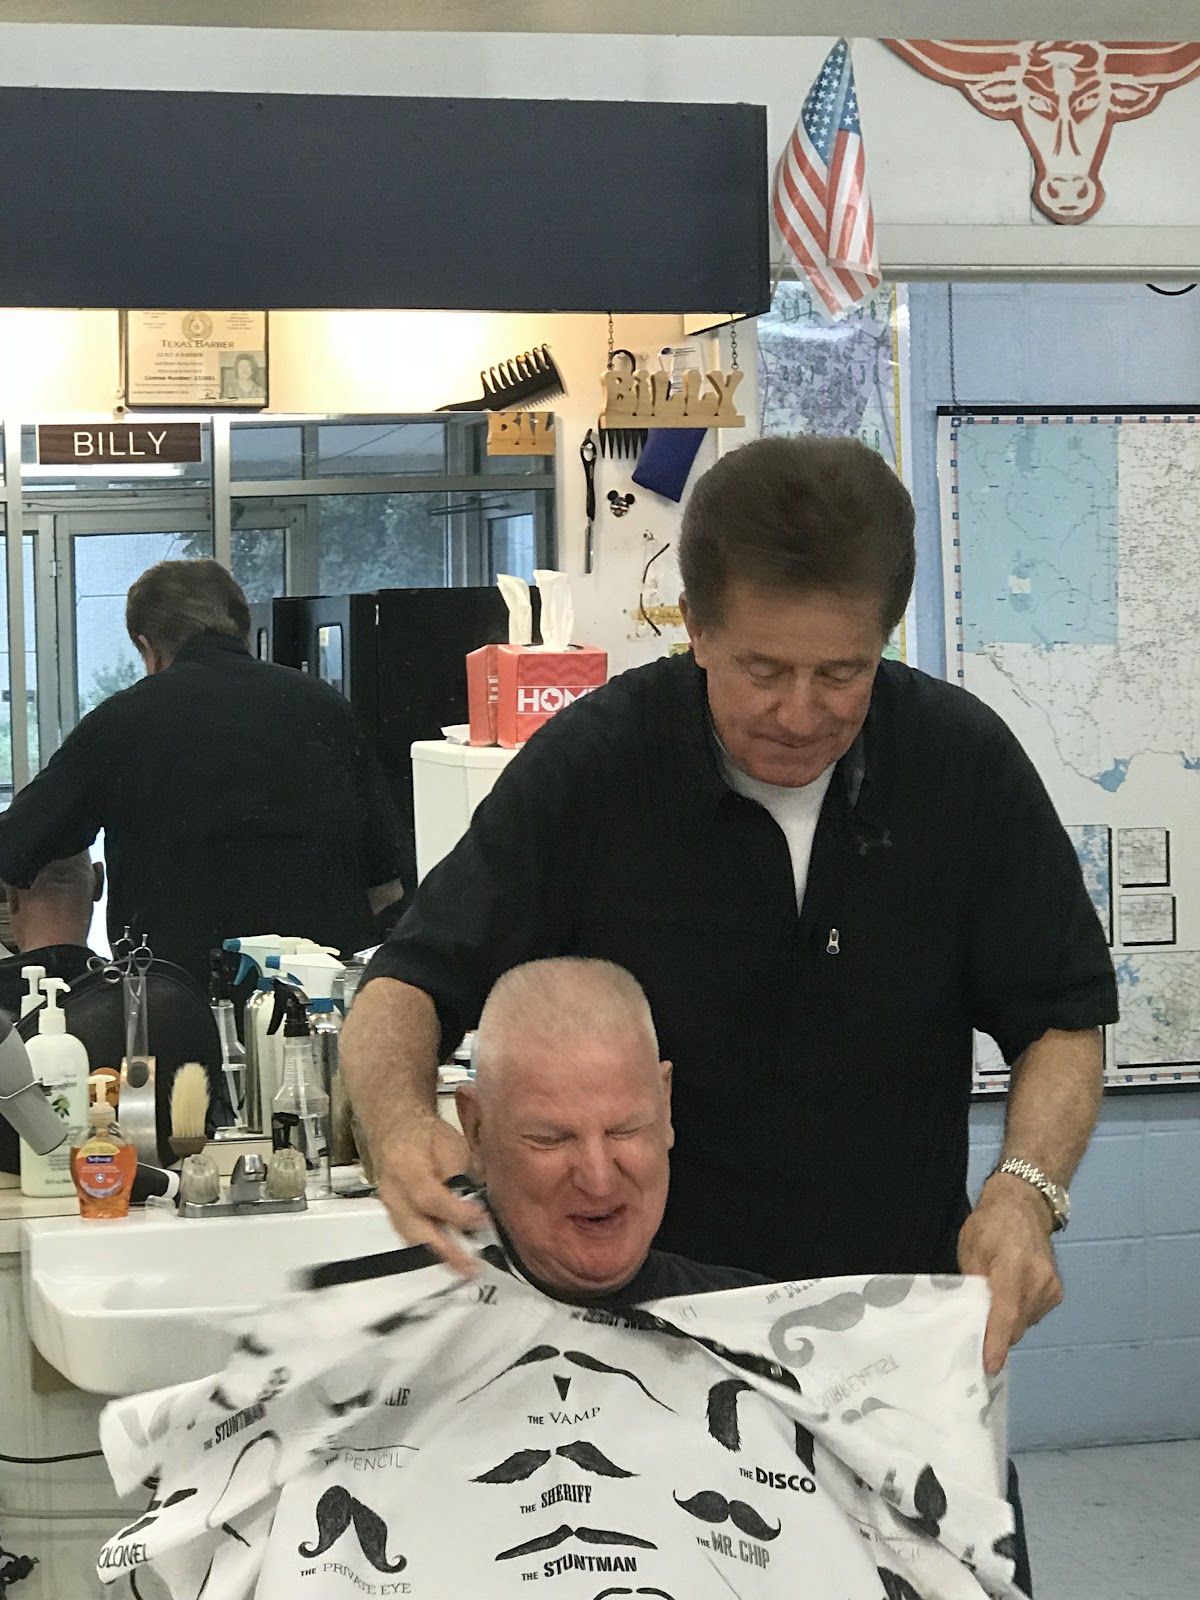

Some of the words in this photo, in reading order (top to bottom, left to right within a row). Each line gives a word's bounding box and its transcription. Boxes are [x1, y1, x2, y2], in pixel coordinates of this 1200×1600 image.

[161, 340, 193, 348] TEXAS
[196, 340, 235, 349] BARBER
[600, 369, 744, 416] BILLY
[73, 431, 167, 456] BILLY
[517, 687, 597, 712] HOM
[527, 1415, 545, 1425] THE
[549, 1407, 601, 1425] VAMP
[344, 1452, 404, 1471] PENCIL
[739, 1467, 753, 1480] THE
[755, 1467, 817, 1494] DISCO
[519, 1504, 537, 1515] THE
[541, 1484, 592, 1509] SHERIFF
[696, 1536, 711, 1549] THE
[711, 1530, 738, 1560] MR.
[739, 1539, 770, 1570] CHIP
[300, 1567, 317, 1577] THE
[323, 1562, 377, 1596] PRIVATE
[381, 1582, 412, 1596] EYE
[521, 1571, 539, 1581] THE
[543, 1553, 638, 1577] STUNTMAN
